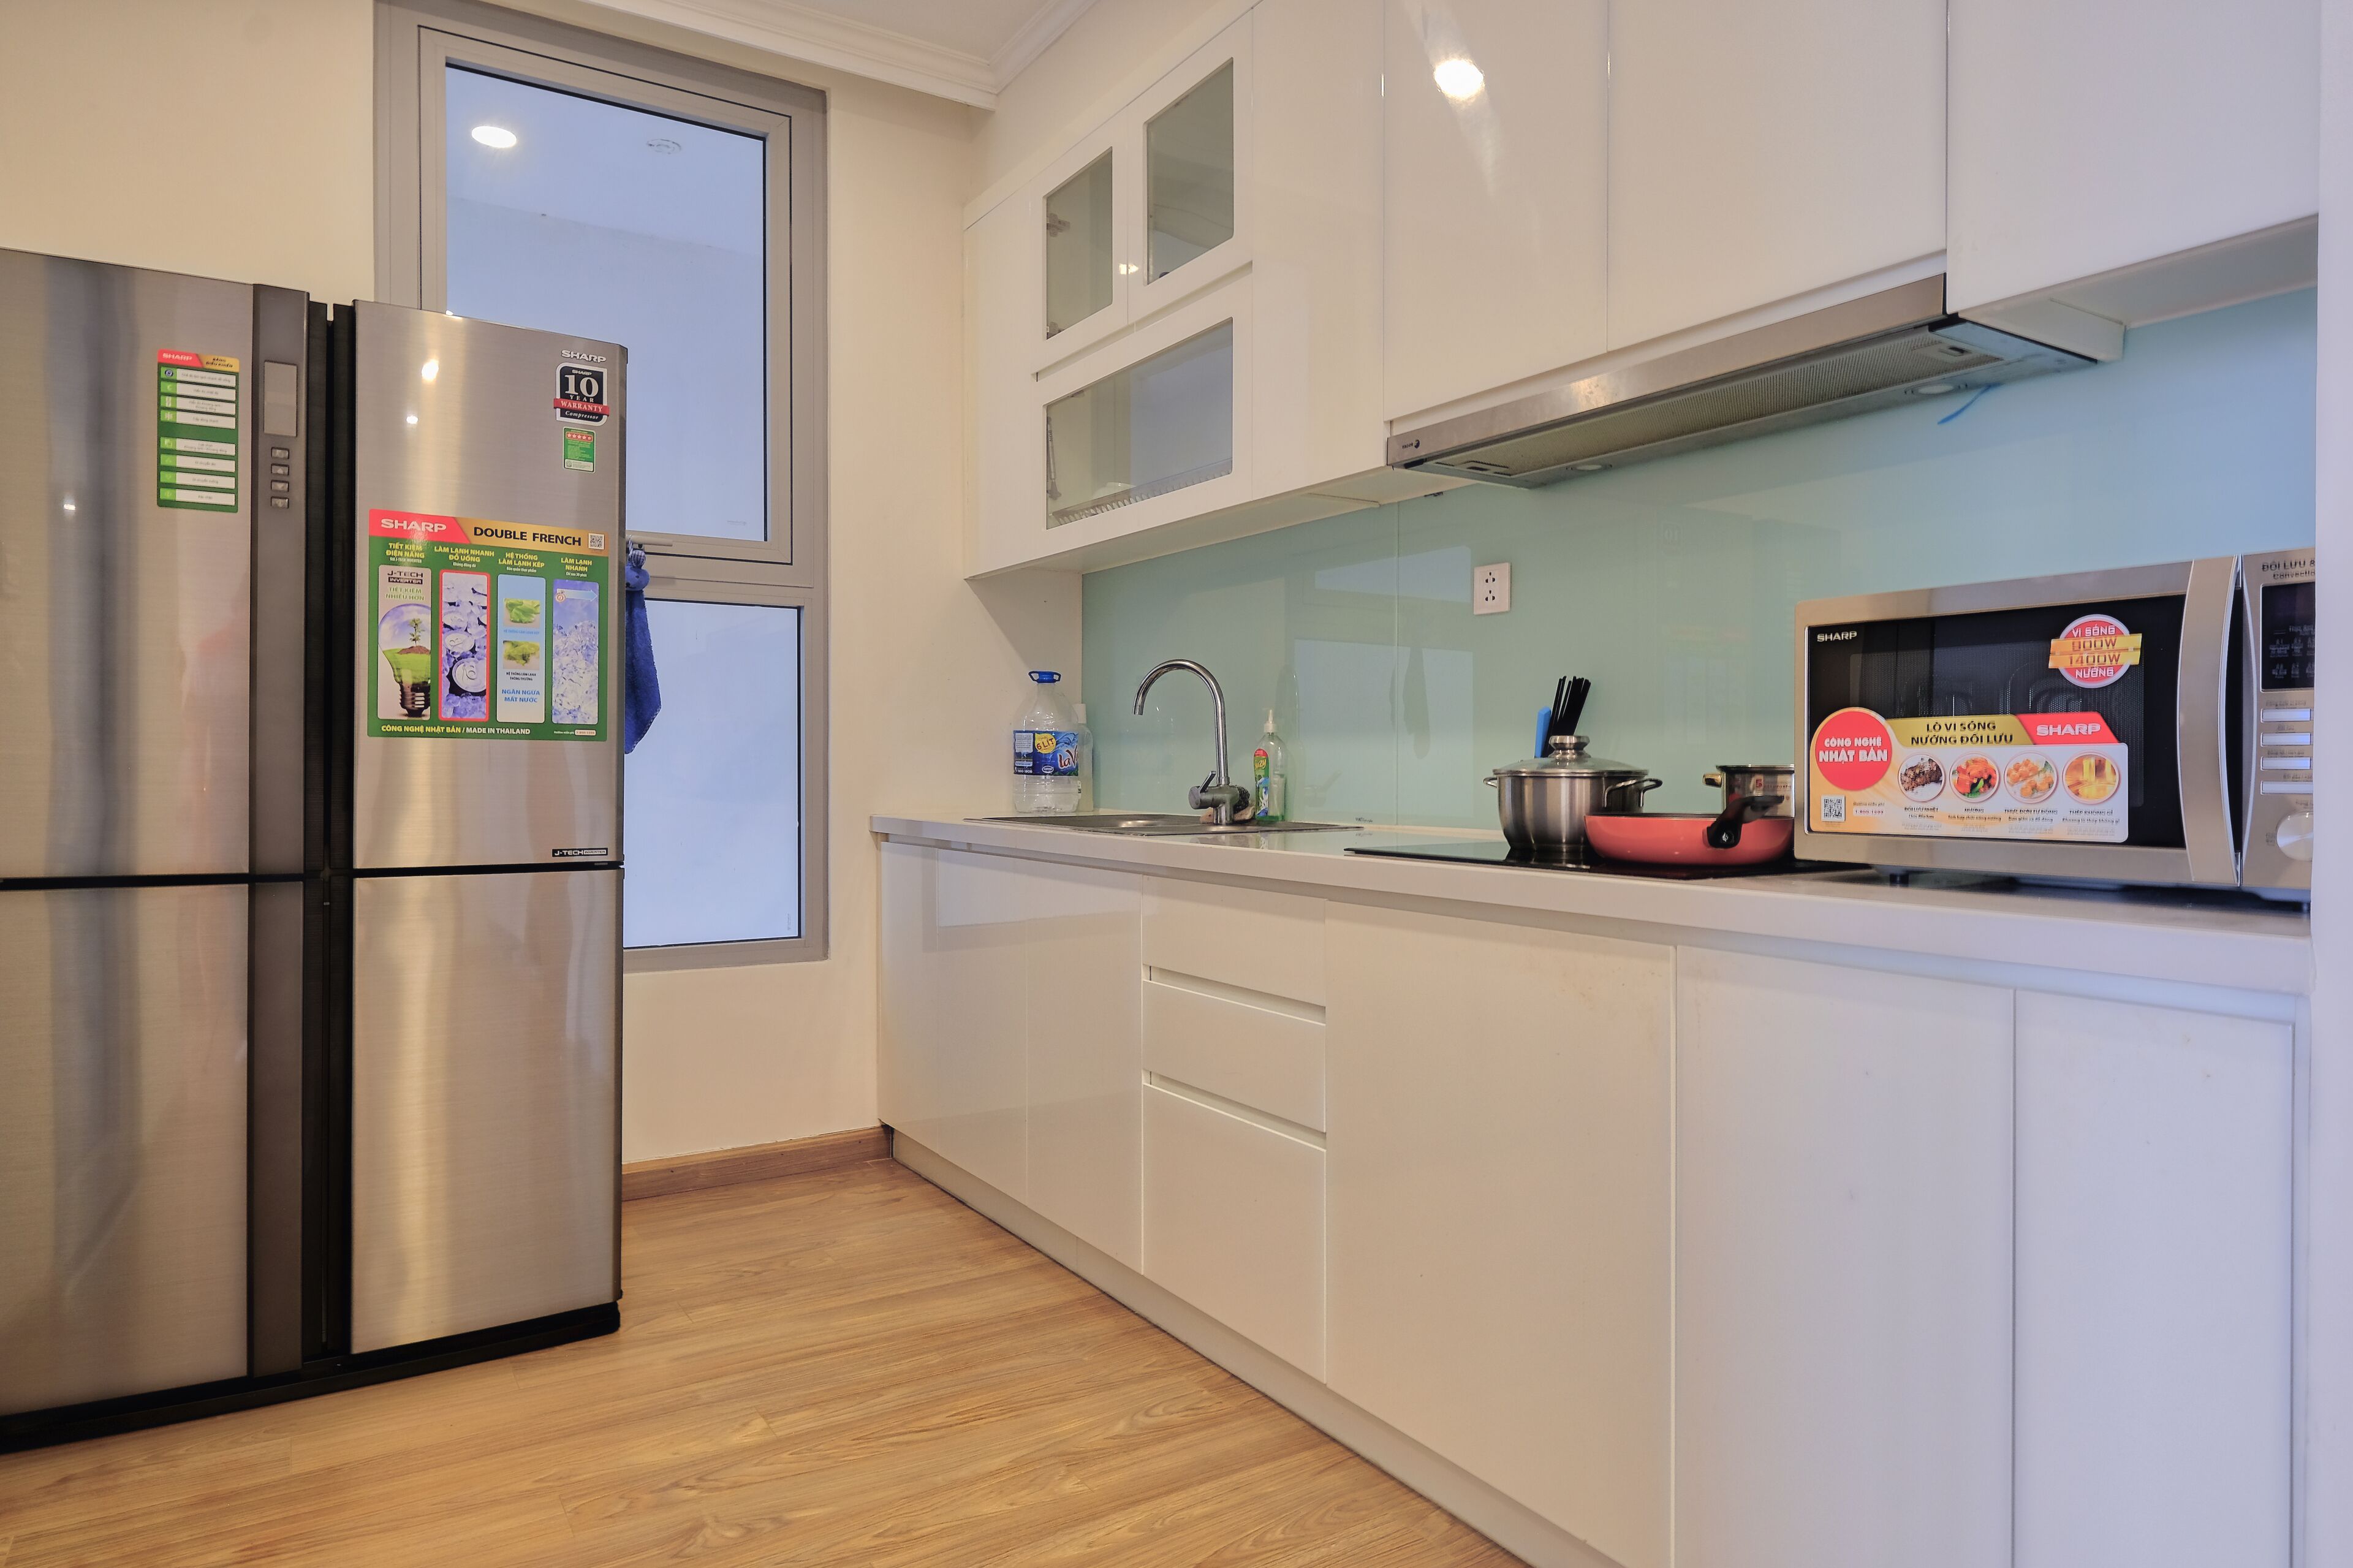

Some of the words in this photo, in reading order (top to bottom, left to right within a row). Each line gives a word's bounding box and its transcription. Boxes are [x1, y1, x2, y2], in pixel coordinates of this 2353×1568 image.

[162, 352, 193, 361] SHARP
[561, 350, 606, 363] SHARP
[564, 374, 599, 398] 10
[560, 400, 603, 412] WARRANTY
[565, 411, 599, 420] Compressor
[381, 519, 447, 532] SHARP
[473, 526, 528, 541] DOUBLE
[532, 532, 582, 547] FRENCH
[461, 554, 481, 562] UỐNG
[2283, 559, 2306, 570] LƯU
[1817, 631, 1857, 642] SHARP
[2072, 629, 2082, 638] VI
[2085, 624, 2116, 637] SÓNG
[2069, 653, 2121, 667] 1400W
[2075, 665, 2114, 678] NƯỚNG
[404, 725, 424, 734] NGHỆ
[425, 725, 445, 734] NHẬT
[1927, 722, 1942, 733] LÒ
[1945, 723, 1957, 732] VI
[1960, 721, 1996, 732] SÓNG
[2036, 723, 2101, 737] SHARP
[1824, 737, 1852, 748] CÔNG
[1854, 735, 1882, 748] NGHỆ
[1911, 734, 1957, 746] NƯỚNG
[1987, 732, 2013, 744] LƯU
[1819, 748, 1855, 764] NHẬT
[1859, 746, 1888, 762] BẢN
